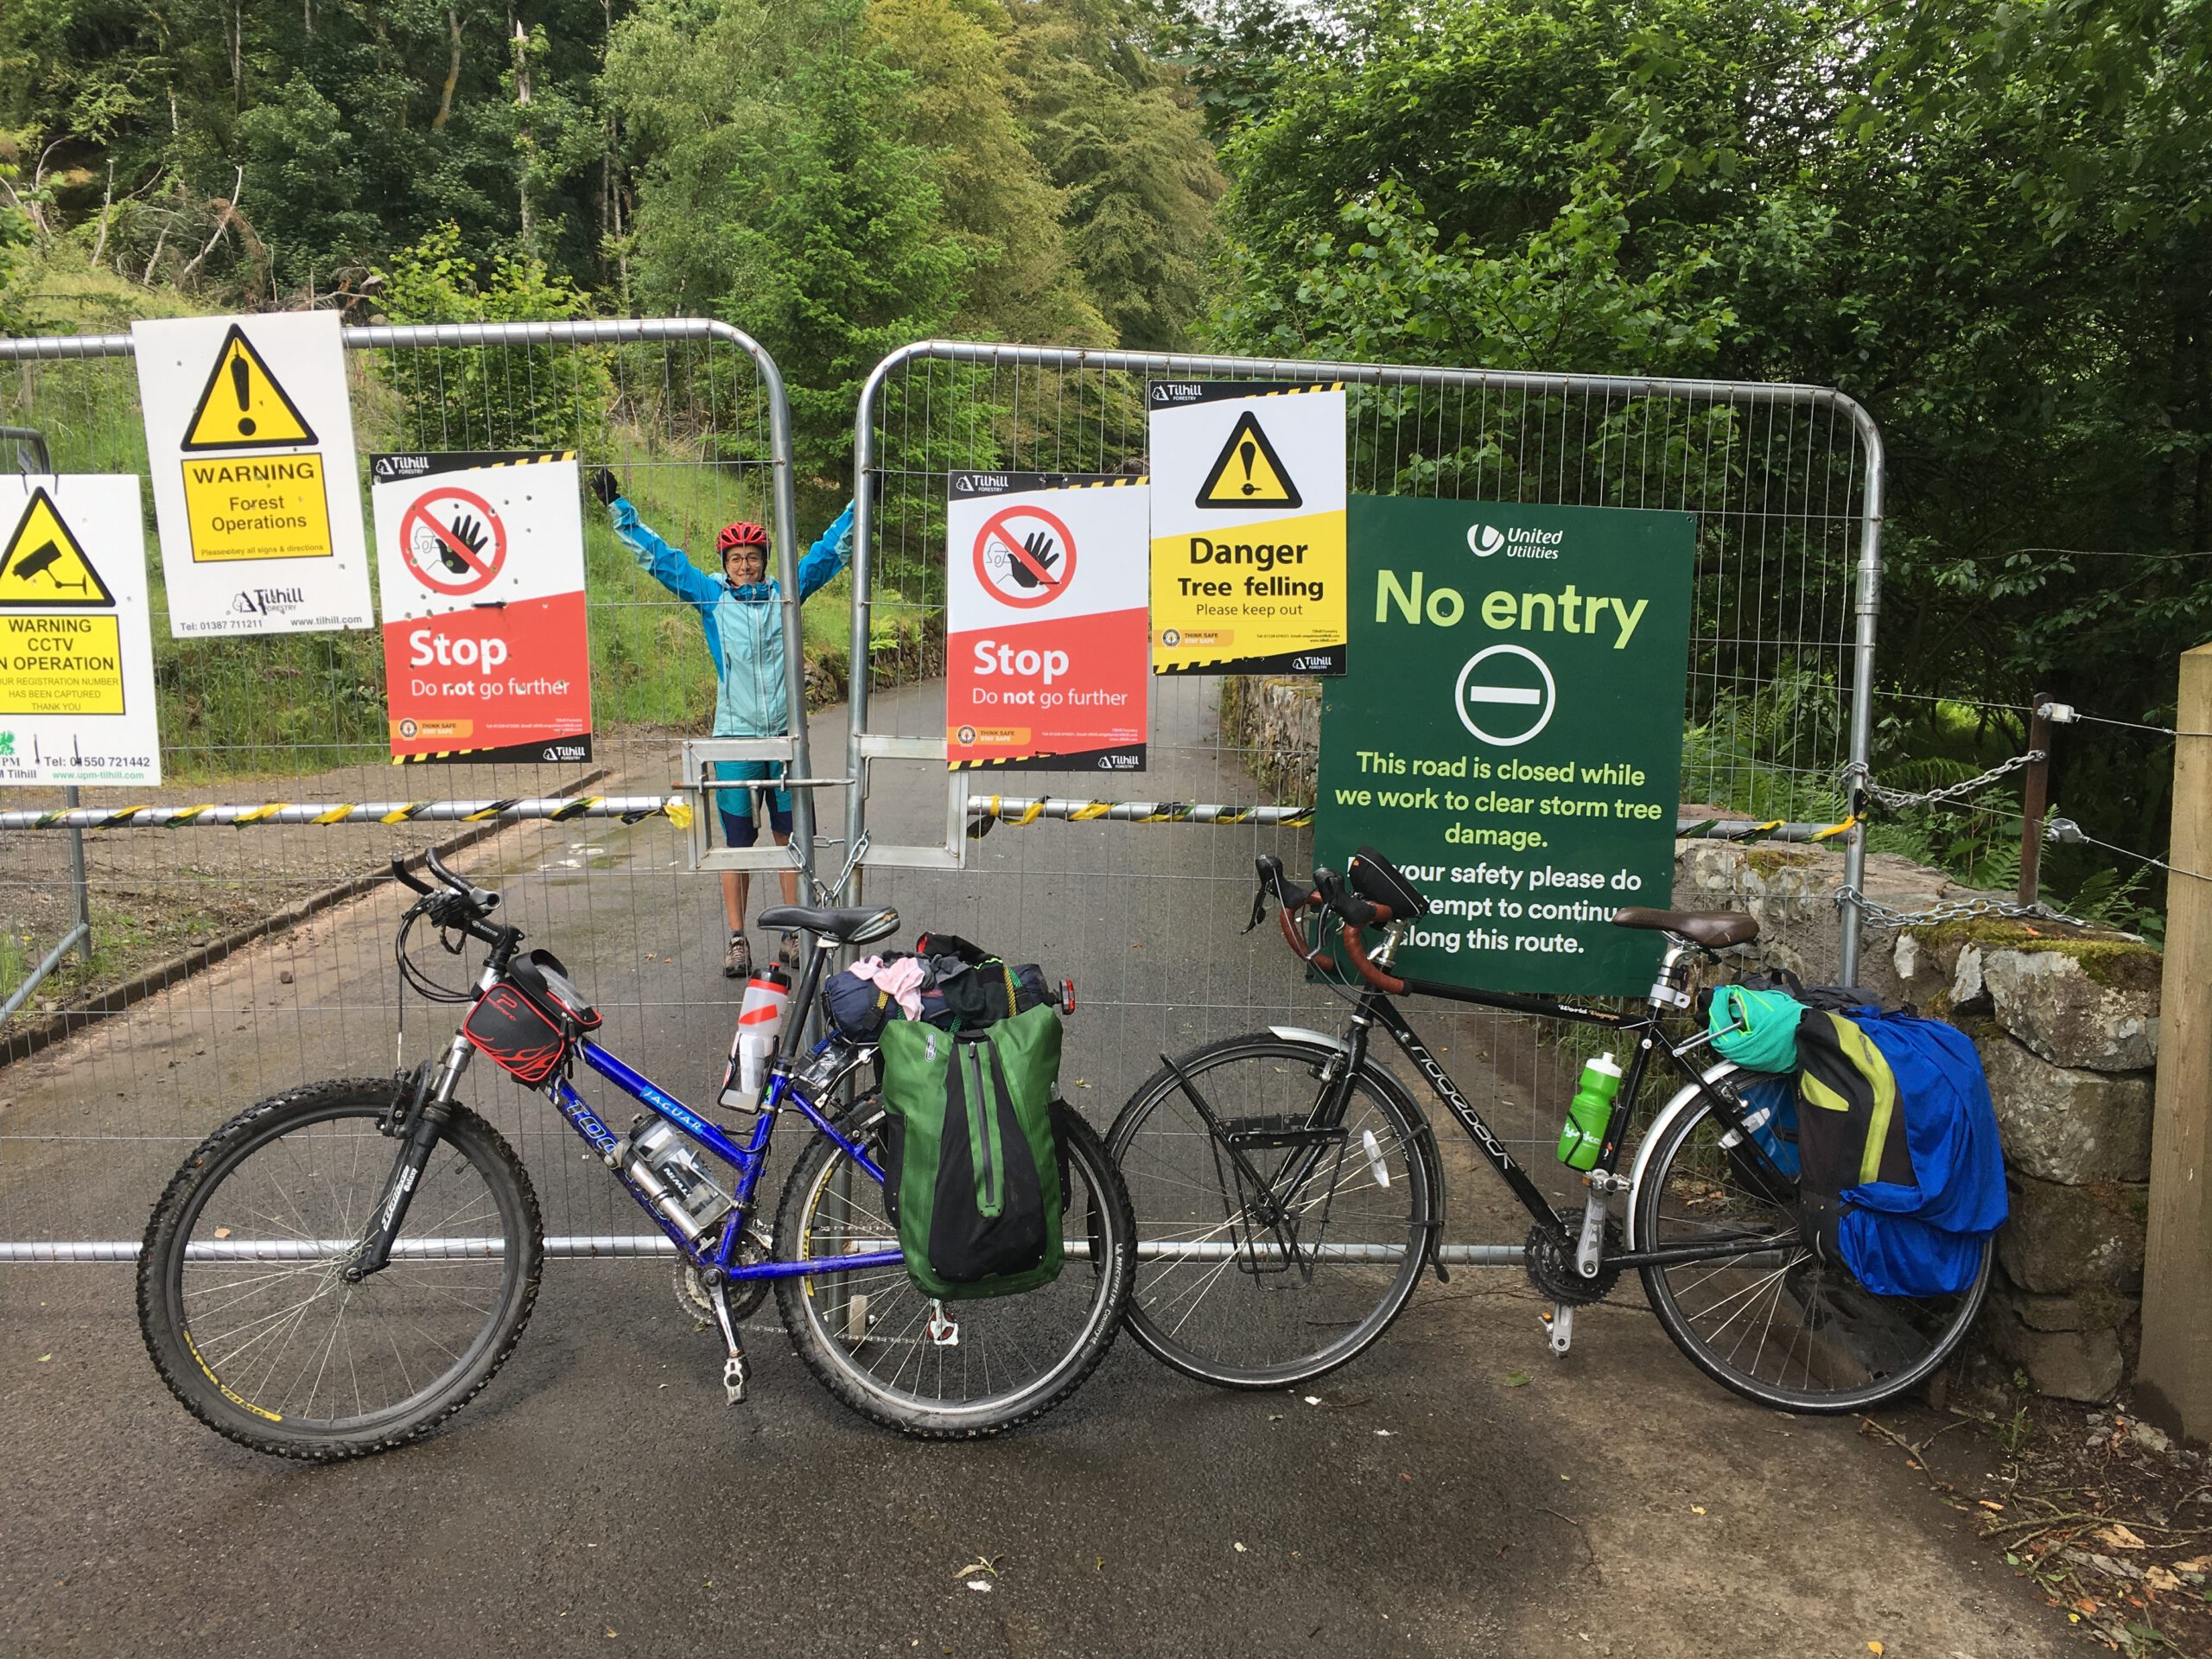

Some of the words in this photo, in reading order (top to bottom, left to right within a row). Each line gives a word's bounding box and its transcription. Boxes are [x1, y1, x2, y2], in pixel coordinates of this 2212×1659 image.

[1167, 385, 1202, 396] Tilhill
[391, 456, 429, 469] Tilhill
[193, 462, 315, 484] WARNING
[972, 474, 1009, 487] Tilhill
[229, 495, 285, 512] Forest
[212, 514, 307, 535] Operations
[1507, 527, 1563, 544] United
[200, 548, 226, 556] Please
[226, 547, 245, 556] obey
[257, 545, 277, 555] signs
[286, 543, 324, 553] directions
[1190, 537, 1308, 572] Danger
[1507, 544, 1559, 560] Utilities
[1177, 577, 1232, 596] Tree
[1244, 575, 1324, 601] felling
[253, 588, 304, 606] Tilhill
[1196, 603, 1238, 615] Please
[1243, 603, 1275, 618] keep
[1280, 604, 1303, 615] out
[1375, 569, 1465, 627] No
[1481, 584, 1649, 650] entry
[8, 619, 92, 632] WARNING
[180, 621, 199, 631] Tel:
[200, 620, 228, 631] 01387
[230, 619, 263, 629] 711211
[290, 615, 362, 627] www.tilhill.com
[27, 638, 74, 652] CCTV
[409, 629, 508, 675] Stop
[0, 657, 8, 671] N
[13, 656, 115, 671] OPERATION
[973, 639, 1070, 685] Stop
[1305, 656, 1332, 666] Tilhill
[16, 677, 80, 686] REGISTRATION
[81, 677, 119, 686] NUMBER
[411, 679, 437, 696] Do
[442, 680, 474, 696] not
[480, 682, 504, 700] go
[508, 677, 570, 696] further
[9, 690, 27, 698] HAS
[29, 690, 52, 698] BEEN
[54, 690, 101, 698] CAPTURED
[973, 688, 998, 704] Do
[1003, 690, 1035, 705] not
[1039, 692, 1064, 709] go
[1067, 688, 1128, 706] further
[32, 702, 60, 711] THANK
[62, 702, 81, 711] YOU
[556, 747, 586, 756] Tilhill
[2, 757, 21, 766] PM
[44, 756, 67, 767] Tel:
[69, 757, 105, 767] 01550
[109, 756, 150, 767] 721442
[1110, 755, 1140, 765] Tilhill
[8, 769, 37, 779] Tilhill
[52, 770, 145, 780] www.upm-tilhill.com
[1356, 750, 1406, 775] This
[1412, 755, 1467, 779] road
[1472, 757, 1491, 779] is
[1497, 758, 1575, 784] closed
[1580, 762, 1646, 787] while
[1335, 788, 1372, 806] we
[1377, 786, 1440, 810] work
[1444, 790, 1470, 811] to
[1474, 791, 1535, 814] clear
[1539, 794, 1609, 818] storm
[1614, 798, 1662, 820] tree
[1444, 822, 1549, 852] damage.
[1450, 861, 1524, 890] safety
[1529, 865, 1606, 892] please
[1611, 868, 1643, 892] do
[1497, 898, 1522, 918] to
[1528, 899, 1627, 924] continu
[1466, 927, 1509, 950] this
[1515, 931, 1585, 954] route.
[1558, 1003, 1588, 1014] World
[643, 1090, 702, 1131] JAGUAR
[1108, 1255, 1122, 1306] MICHELIN
